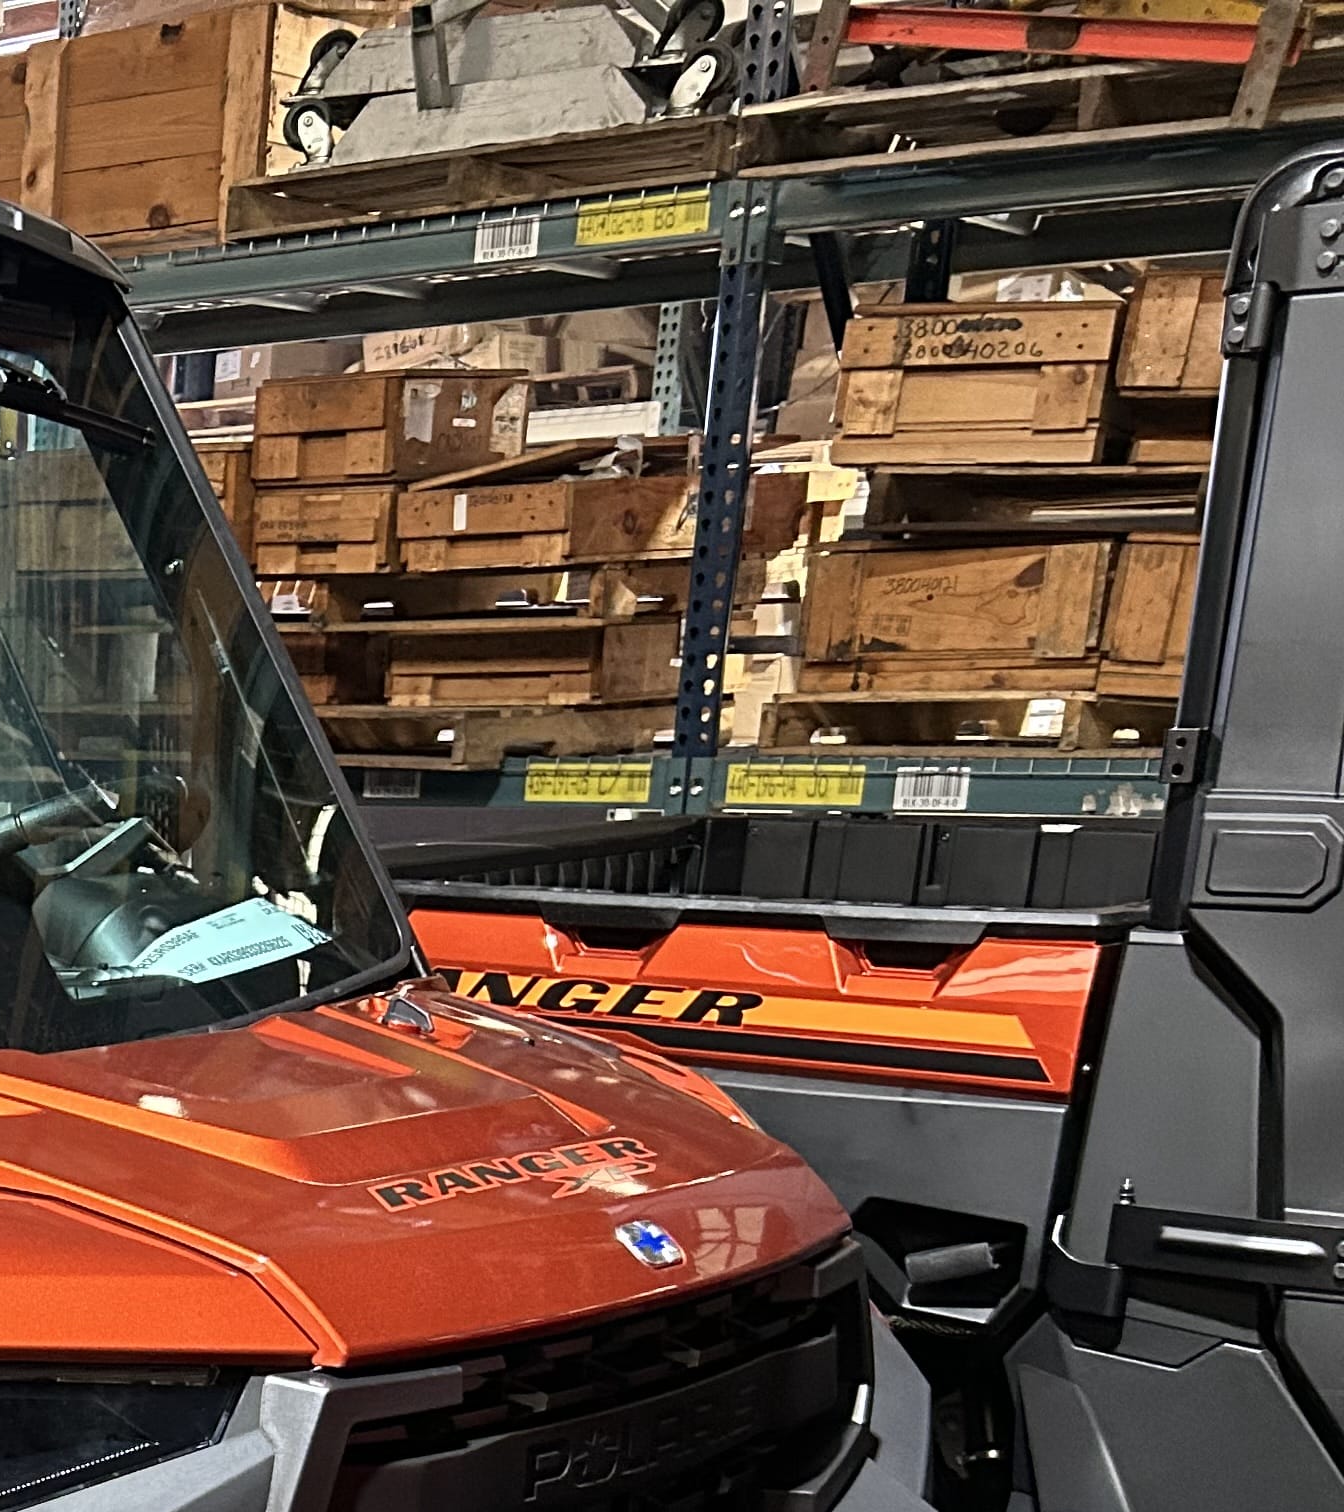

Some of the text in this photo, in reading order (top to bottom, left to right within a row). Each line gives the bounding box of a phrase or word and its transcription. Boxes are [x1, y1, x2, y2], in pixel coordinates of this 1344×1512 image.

[432, 967, 764, 1028] ANGER
[374, 1138, 652, 1209] RANGER
[545, 1160, 656, 1199] XP
